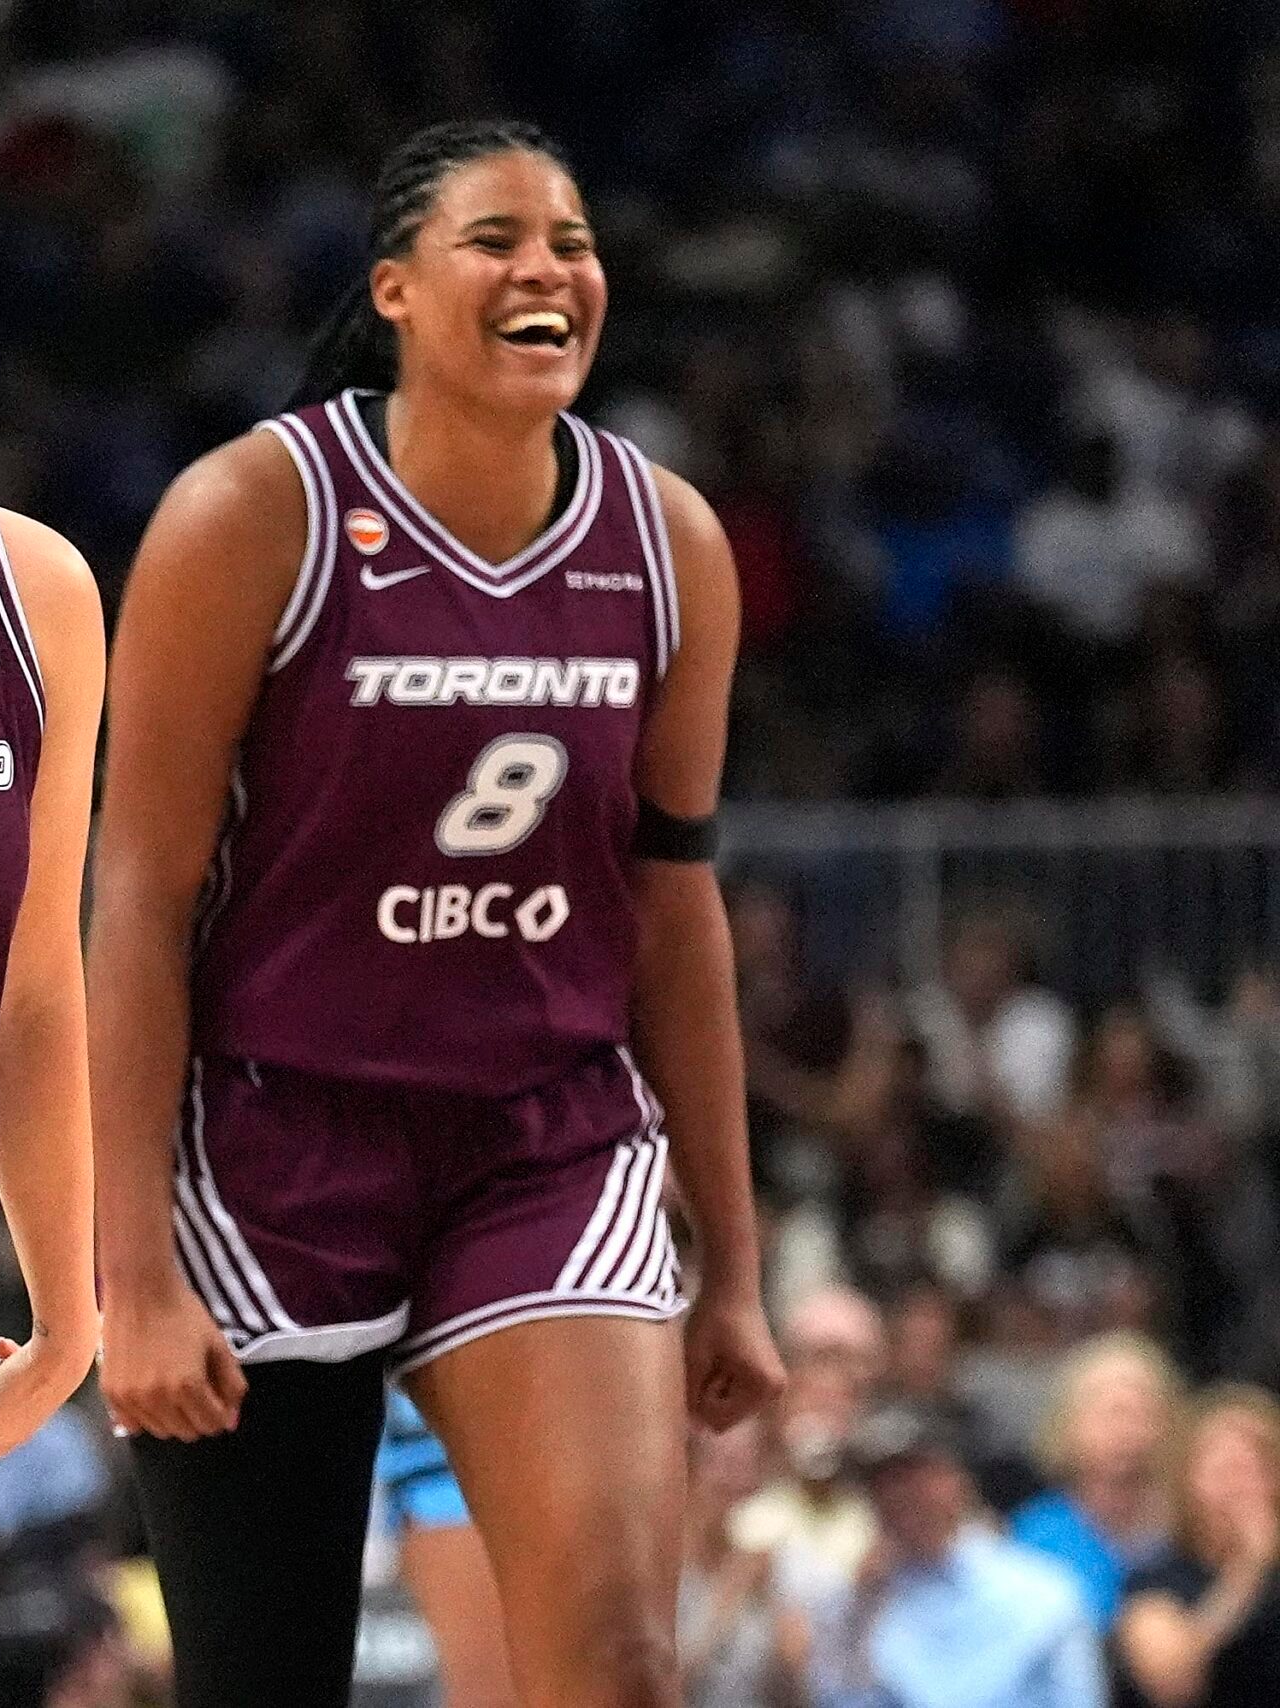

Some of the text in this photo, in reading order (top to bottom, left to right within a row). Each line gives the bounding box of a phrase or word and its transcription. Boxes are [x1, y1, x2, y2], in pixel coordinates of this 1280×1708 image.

[345, 656, 640, 708] TORONTO
[434, 732, 569, 858] 8
[377, 882, 514, 944] CIBC
